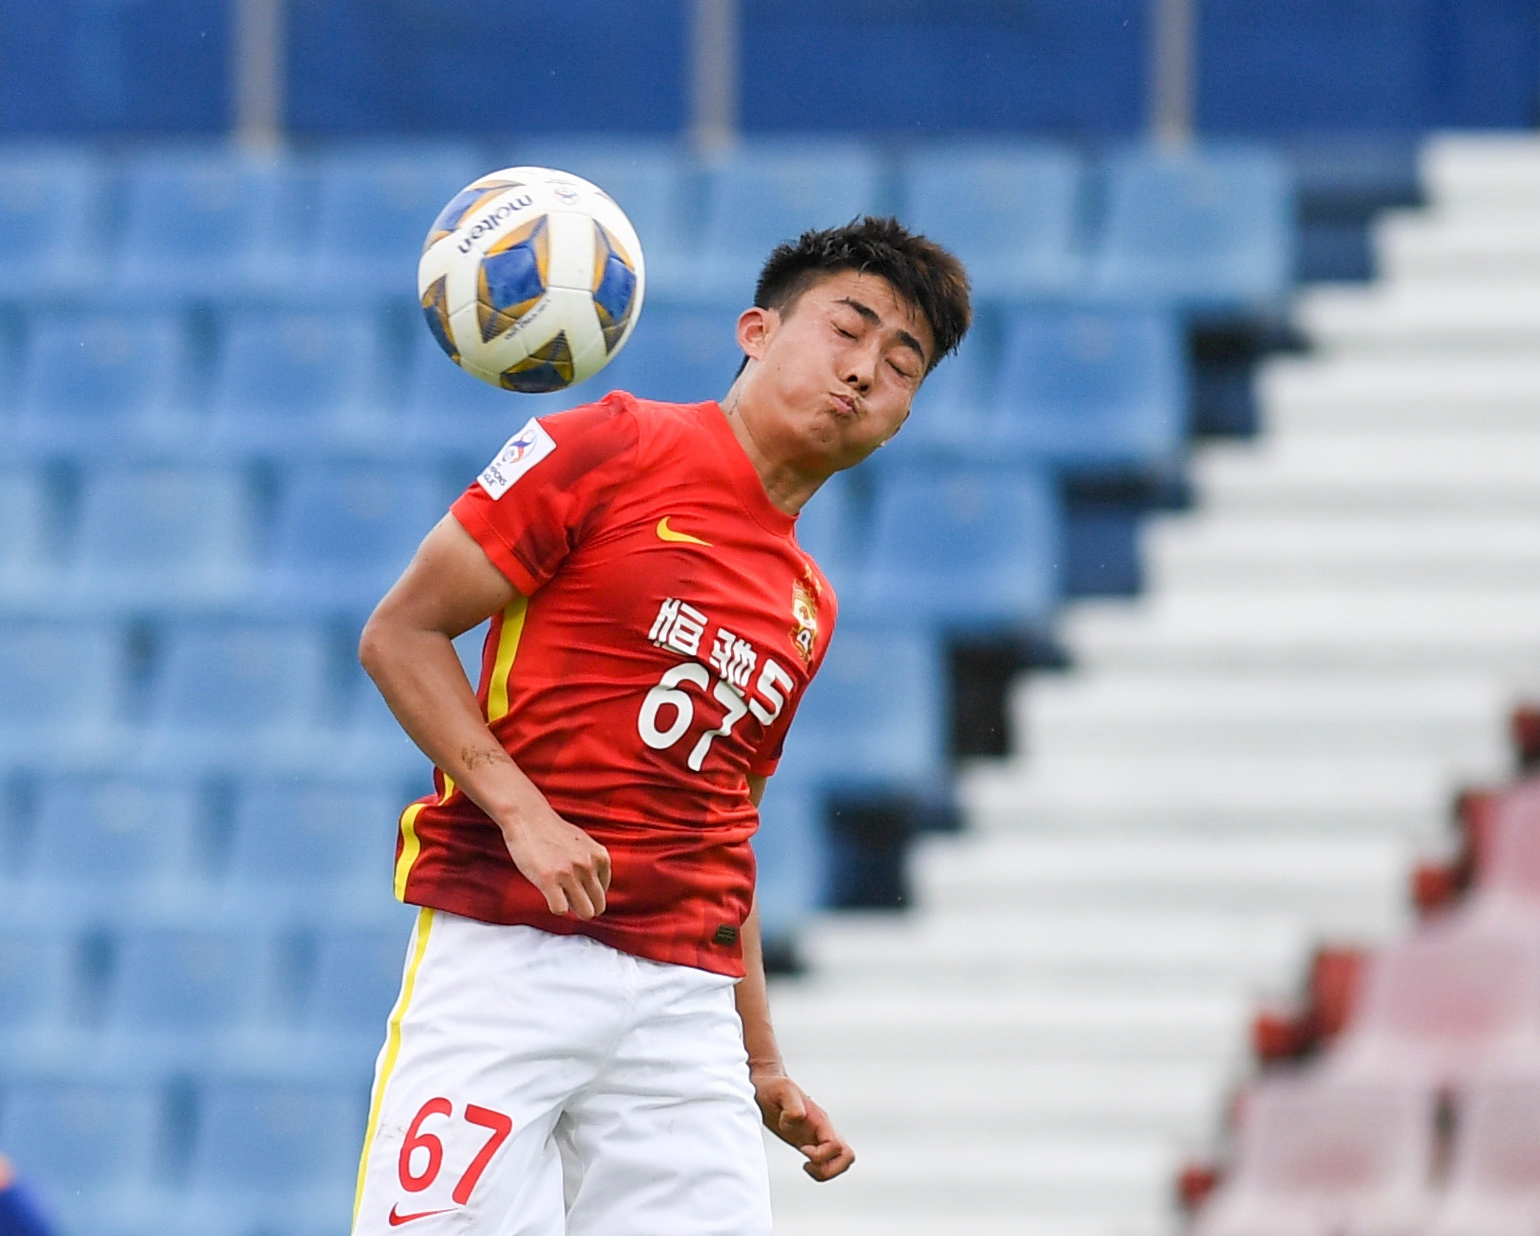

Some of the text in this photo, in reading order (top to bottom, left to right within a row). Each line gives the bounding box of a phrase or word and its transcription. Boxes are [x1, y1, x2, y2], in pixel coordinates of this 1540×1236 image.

[458, 194, 534, 254] molten
[637, 661, 748, 772] 67
[398, 1096, 513, 1206] 67
